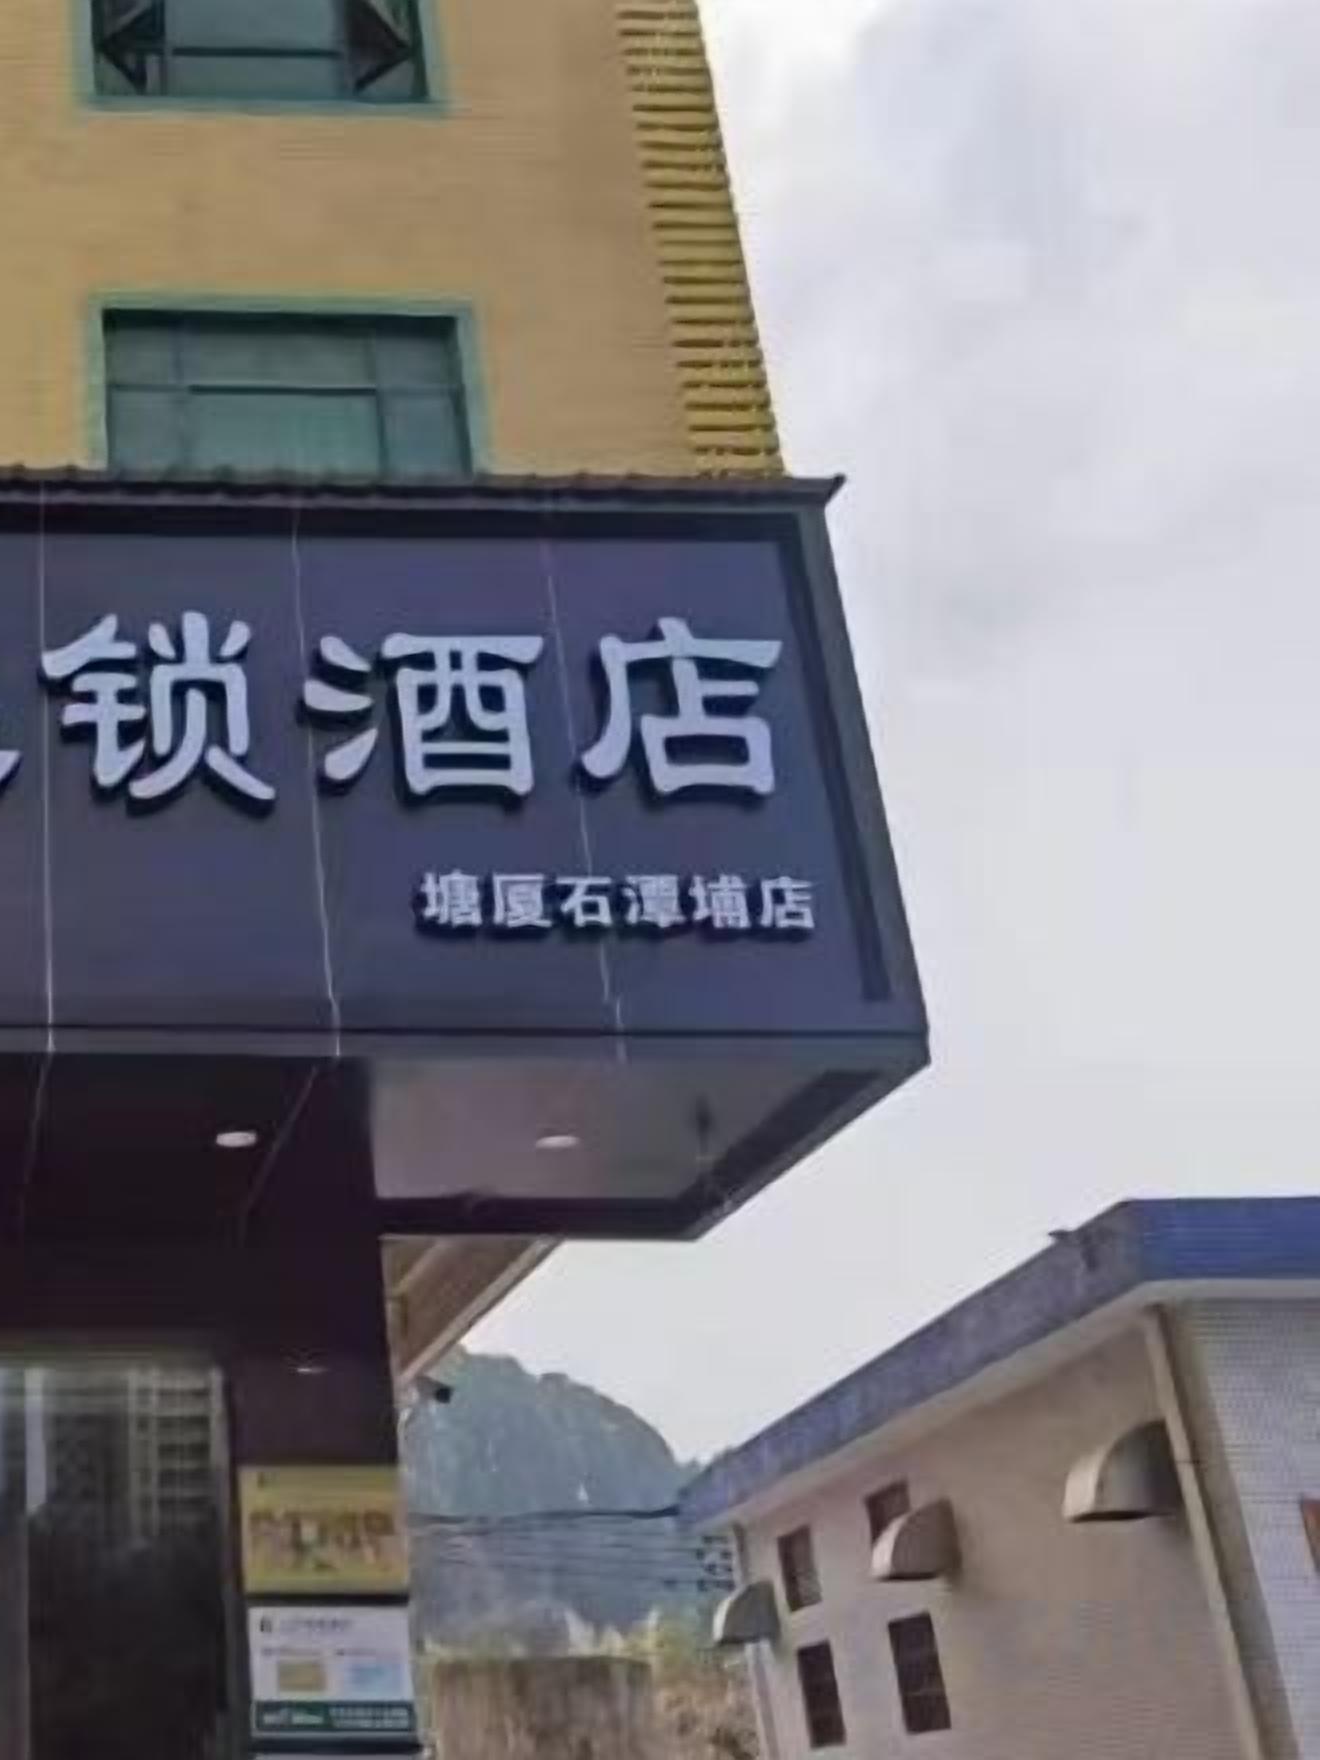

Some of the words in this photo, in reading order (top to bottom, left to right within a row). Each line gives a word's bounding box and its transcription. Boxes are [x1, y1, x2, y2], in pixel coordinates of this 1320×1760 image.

[421, 870, 815, 930] 塘厦石潭埔店
